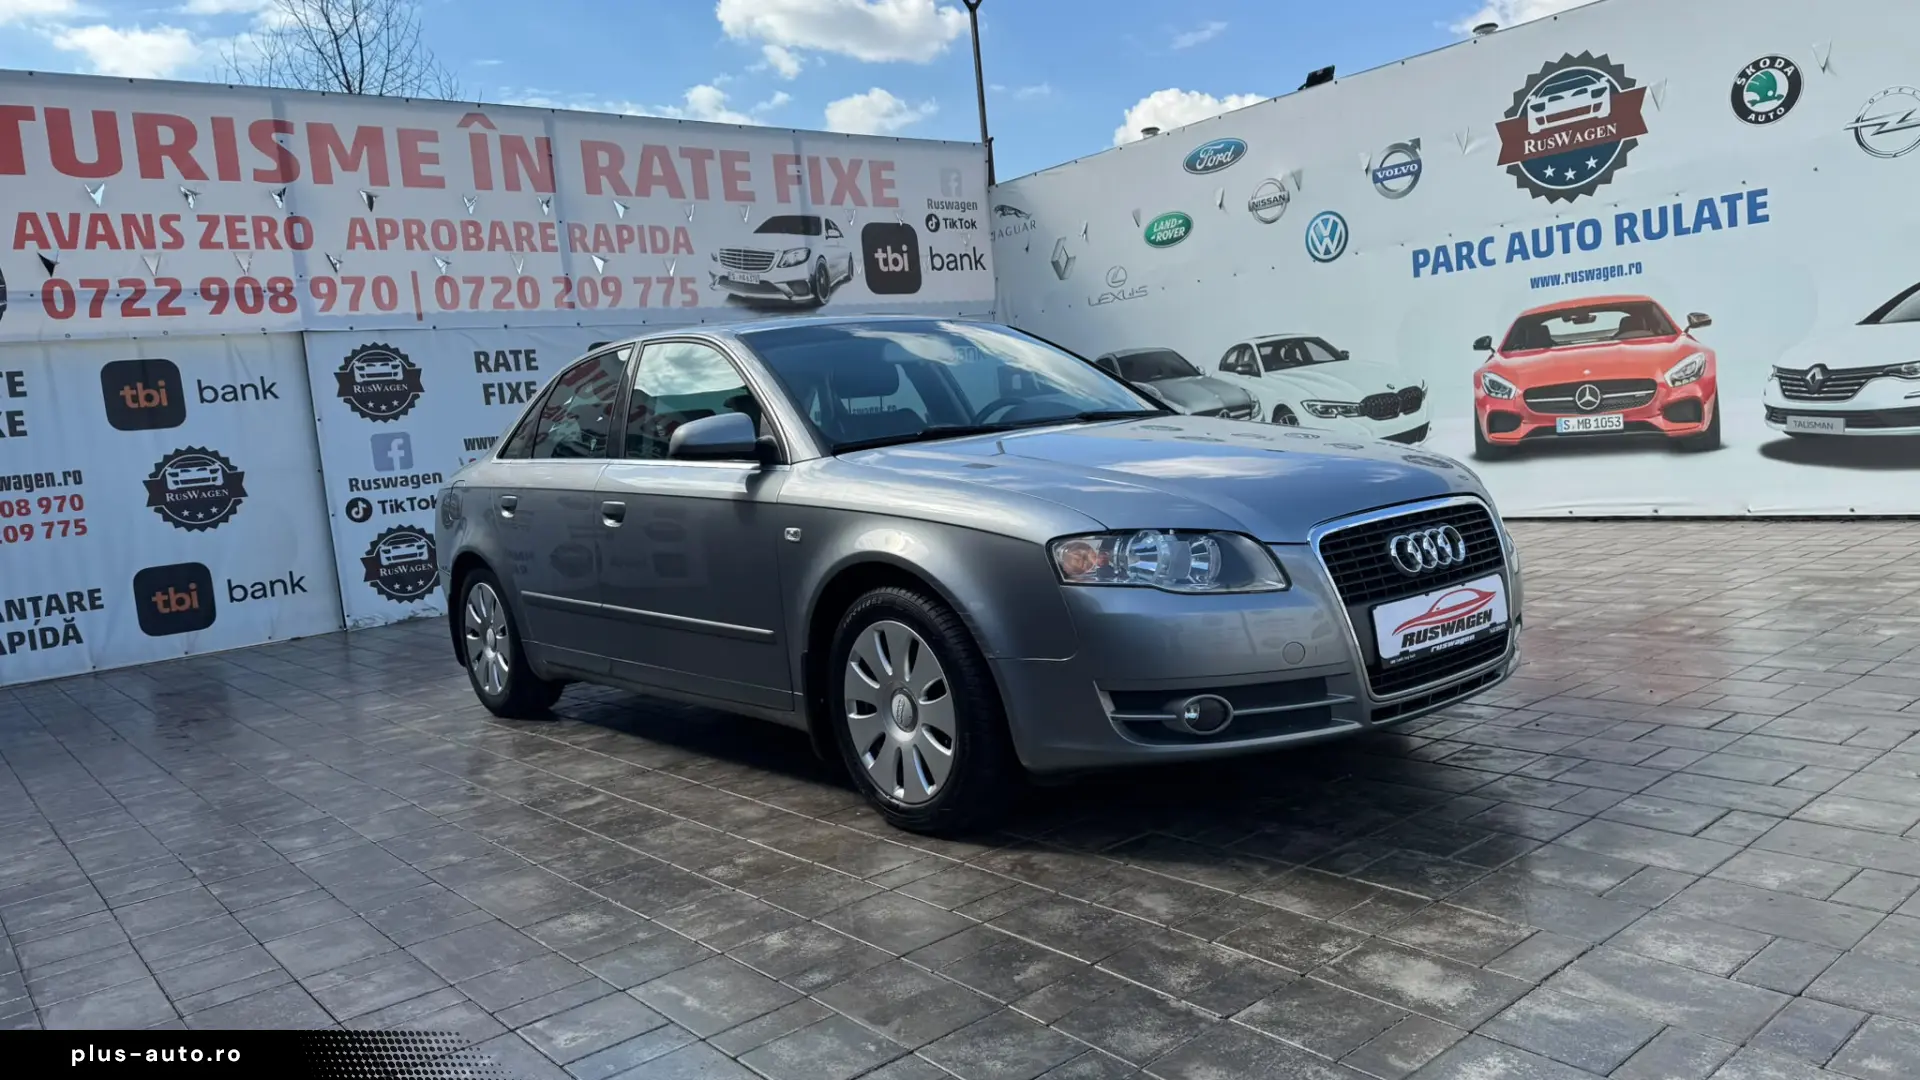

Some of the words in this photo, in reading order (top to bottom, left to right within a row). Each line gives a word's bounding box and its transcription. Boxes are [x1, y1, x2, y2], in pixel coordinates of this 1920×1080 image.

[1736, 58, 1795, 86] SKODA
[1747, 107, 1785, 122] AUTO
[457, 112, 556, 194] ÎN
[580, 139, 756, 204] RATE
[772, 152, 899, 207] FIXE
[1196, 143, 1235, 170] Ford
[1375, 163, 1418, 179] VOLVO
[927, 198, 978, 212] Ruswagen
[1252, 194, 1287, 208] NISSAN
[13, 212, 184, 250] AVANS
[196, 215, 314, 251] ZERO
[346, 217, 558, 253] APROBARE
[568, 223, 695, 255] RAPIDA
[943, 217, 977, 229] TikTok
[1153, 218, 1177, 232] LAND
[1155, 227, 1185, 242] ROVER
[1412, 236, 1496, 277] PARC
[1505, 217, 1602, 263] AUTO
[1614, 187, 1770, 246] RULATE
[874, 245, 909, 272] tbi
[929, 246, 987, 271] bank
[1530, 261, 1643, 289] www.ruswagen.ro
[41, 278, 187, 320] 0722
[200, 277, 298, 315] 908
[309, 276, 398, 312] 970
[434, 276, 541, 310] 0720
[552, 276, 623, 309] 209
[634, 276, 699, 307] 775
[1087, 285, 1148, 307] LEXUS
[473, 349, 539, 373] RATE
[0, 370, 28, 398] E
[119, 380, 169, 409] tbi
[196, 376, 280, 404] bank
[1577, 418, 1592, 430] MB
[1594, 416, 1622, 429] 1053
[1792, 419, 1835, 430] TALISMAN
[349, 472, 443, 492] Ruswagen
[37, 494, 84, 515] 970
[0, 523, 34, 544] 09
[41, 518, 88, 539] 775
[152, 583, 200, 614] tbi
[227, 571, 307, 603] bank
[0, 588, 104, 626] NȚARE
[1401, 608, 1493, 649] RUSWAGEN
[1430, 634, 1475, 653] ruswagen
